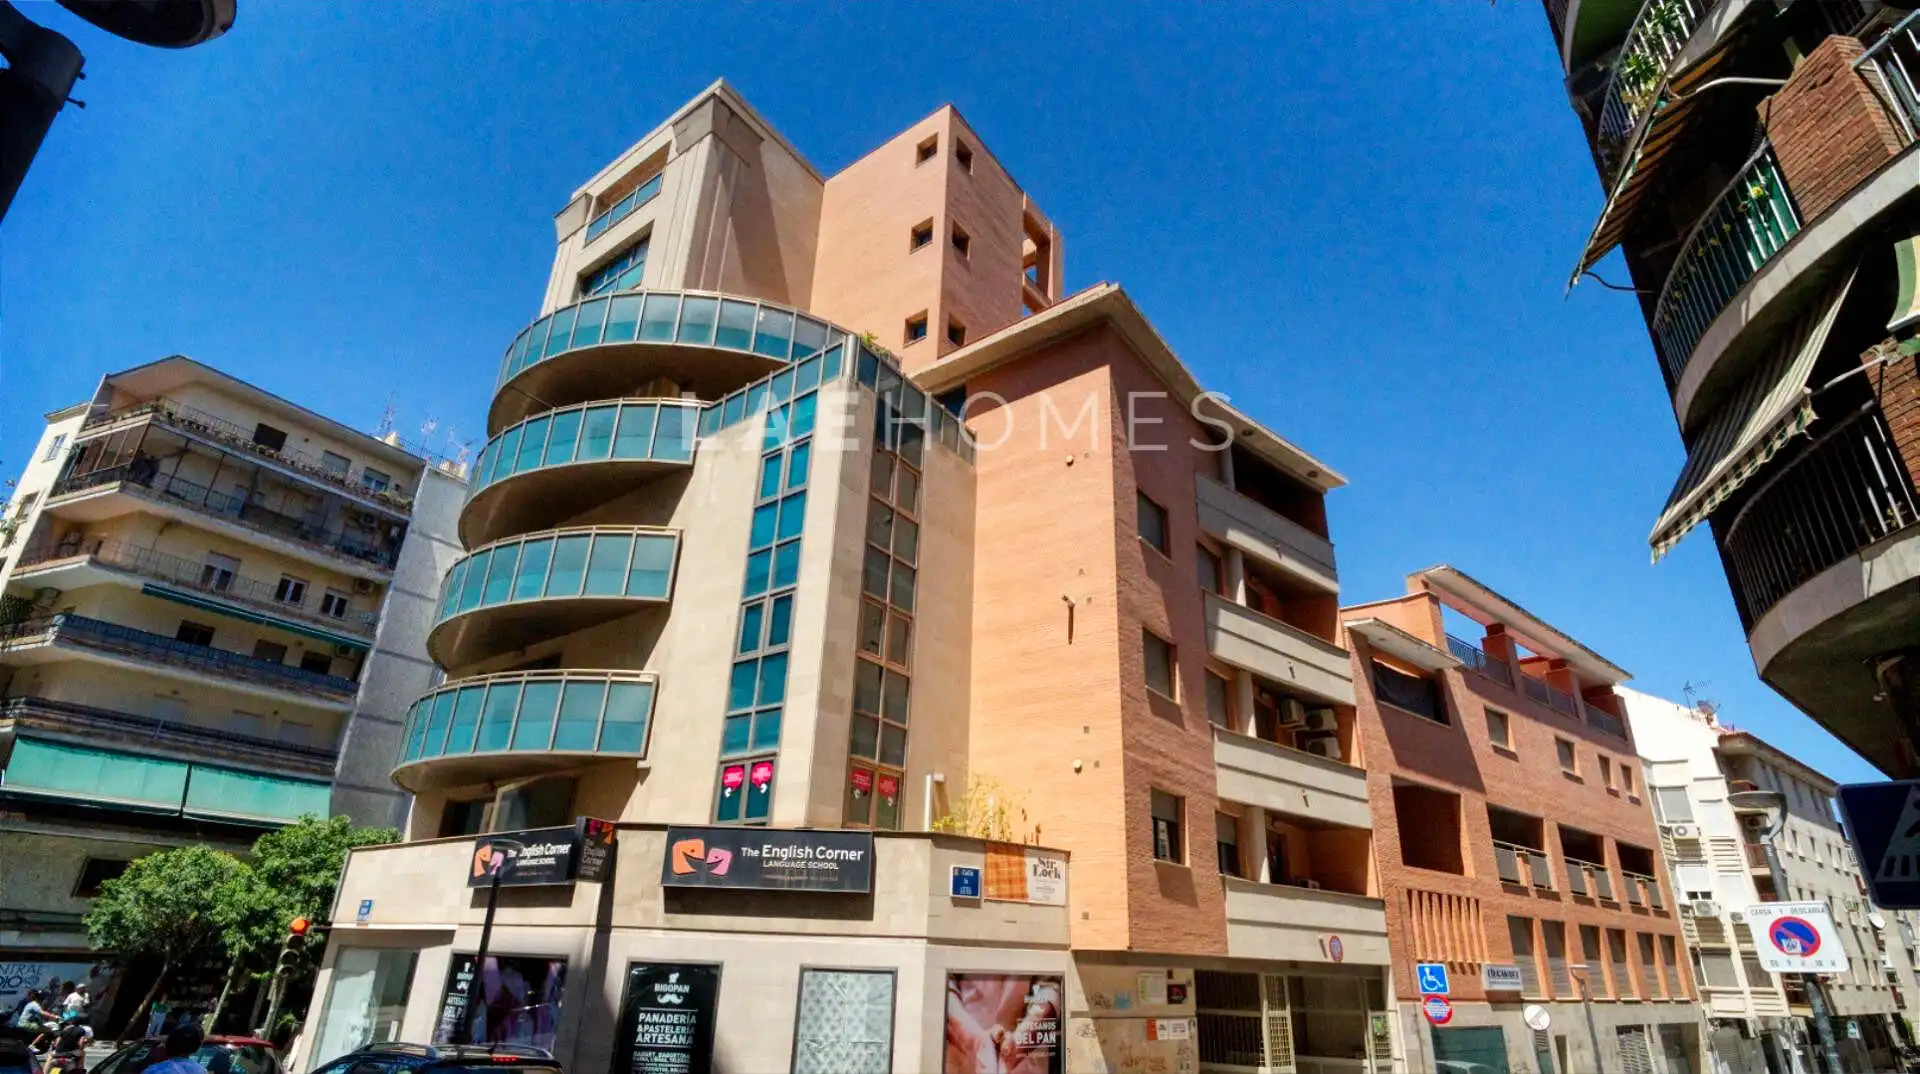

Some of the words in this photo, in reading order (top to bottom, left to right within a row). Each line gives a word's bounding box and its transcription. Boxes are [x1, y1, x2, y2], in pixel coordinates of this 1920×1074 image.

[545, 842, 571, 856] Corner
[741, 847, 760, 857] The
[762, 845, 813, 860] English
[816, 846, 864, 861] Corner
[763, 861, 807, 869] LANGUAGE
[808, 862, 839, 870] SCHOOL
[1038, 856, 1056, 868] Sir
[1033, 864, 1061, 879] Lock
[635, 1033, 693, 1045] ARTESANA
[1037, 1032, 1056, 1043] PAN
